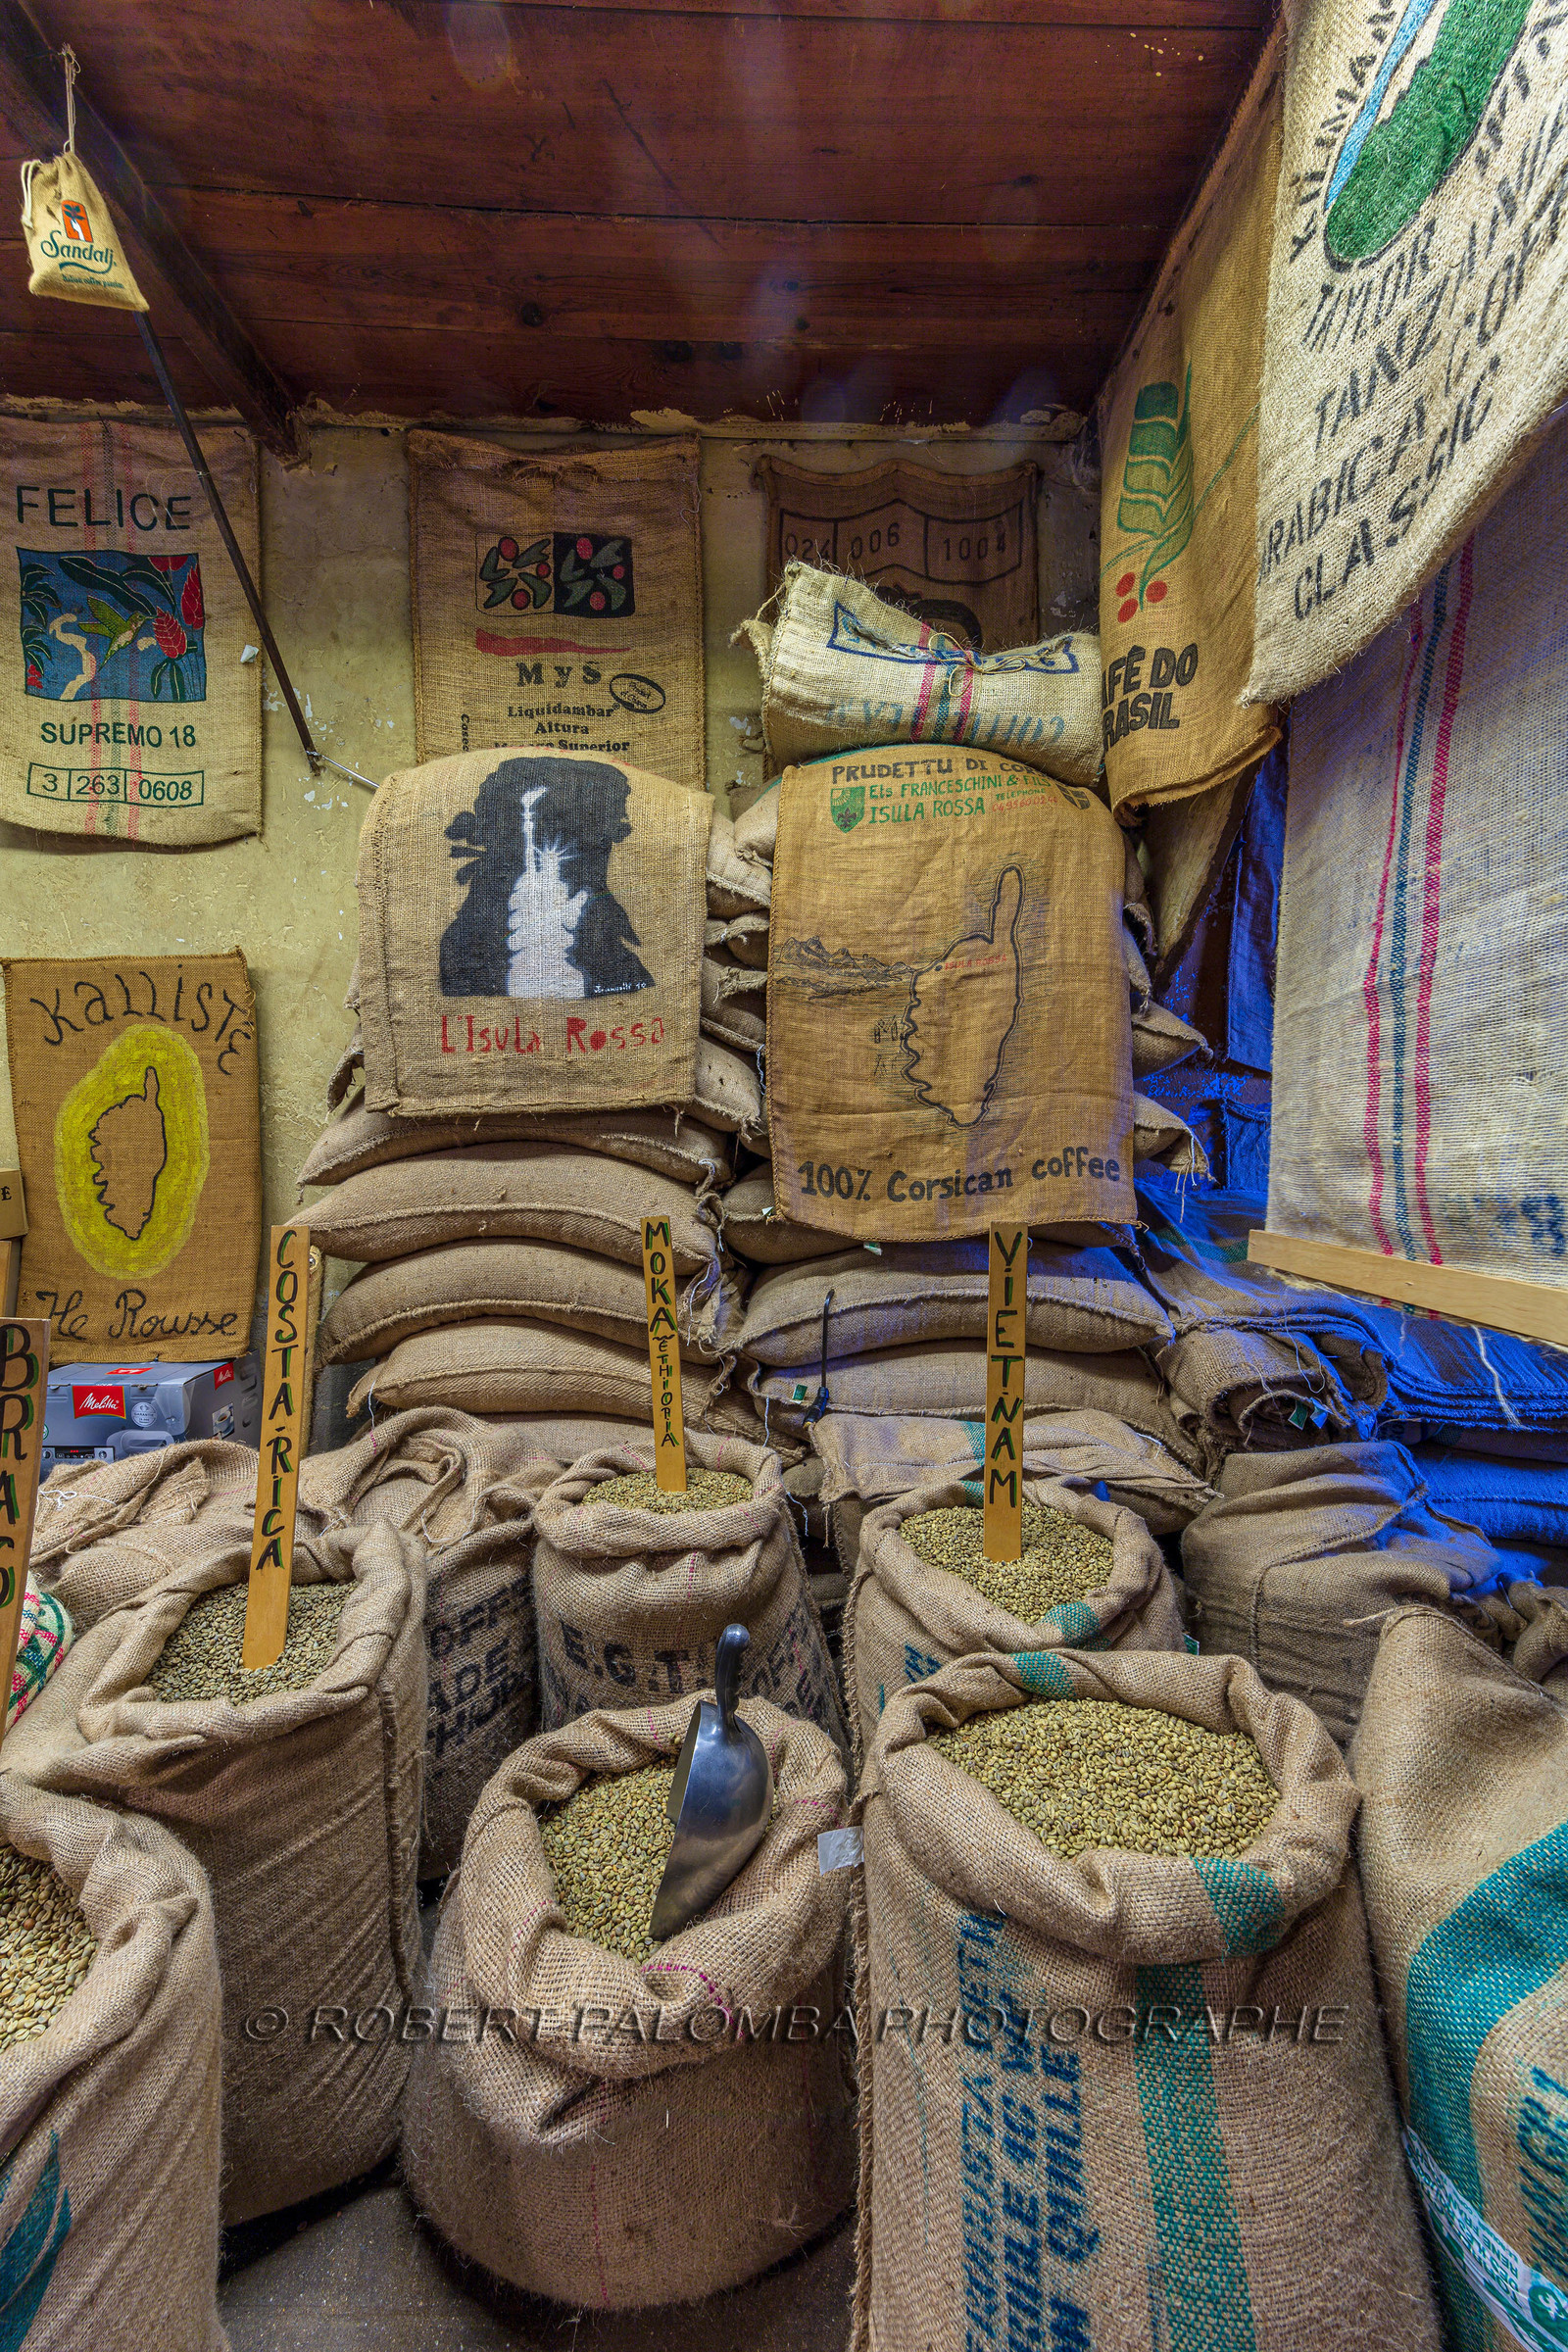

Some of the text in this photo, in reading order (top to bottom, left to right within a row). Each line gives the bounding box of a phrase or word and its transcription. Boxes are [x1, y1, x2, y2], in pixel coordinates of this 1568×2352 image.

[1294, 354, 1501, 620] CLASSIC
[16, 484, 192, 531] FELICE
[850, 521, 901, 561] 006
[1148, 642, 1199, 688] DO
[40, 721, 197, 749] SUPREMO 18
[533, 721, 590, 735] Altura
[41, 773, 192, 801] 3 263 0608
[832, 758, 954, 784] PRUDETTU
[965, 759, 987, 771] DI
[900, 773, 1004, 799] FRANCESCHINI
[1005, 773, 1021, 787] &
[1022, 769, 1052, 787] FILS
[868, 797, 987, 824] ISULA ROSSA
[441, 1014, 665, 1054] L'Isula Rossa
[797, 1145, 1122, 1203] 100% Corsican coffee
[645, 1221, 678, 1335] MOKA
[107, 1288, 239, 1341] Rousse
[79, 1392, 120, 1411] Melitta
